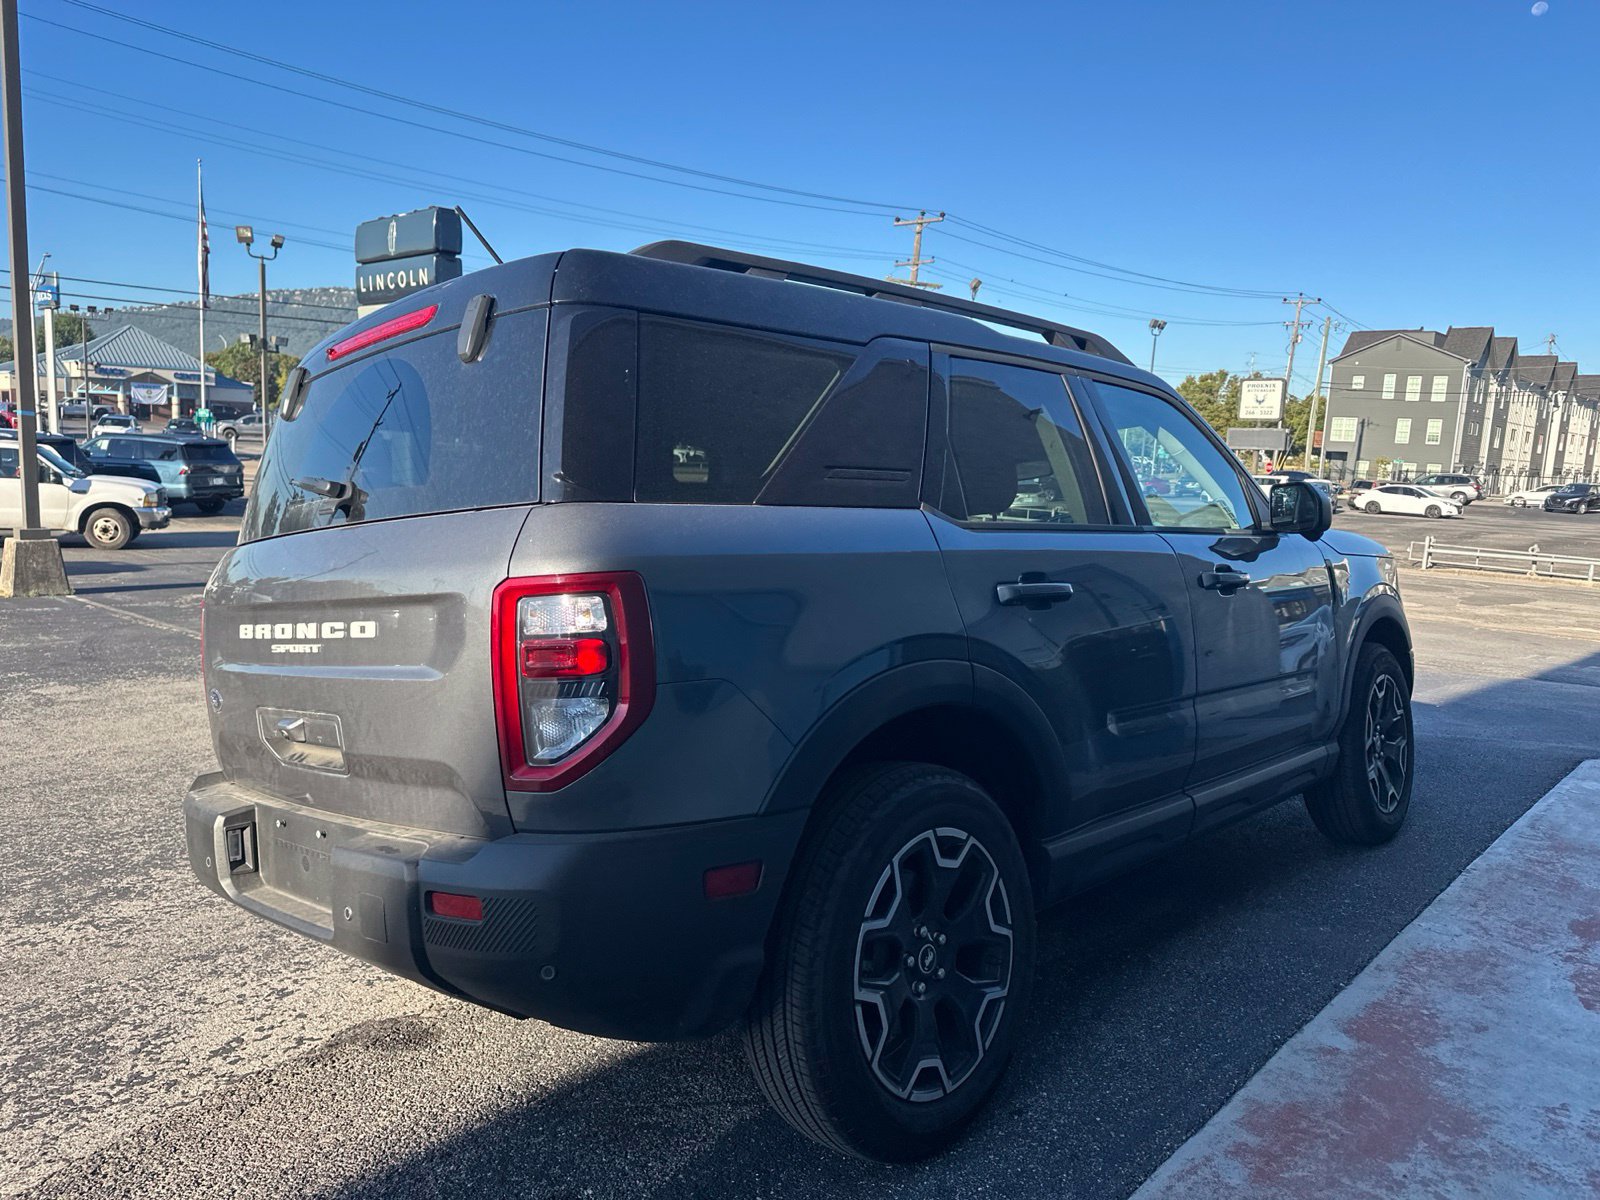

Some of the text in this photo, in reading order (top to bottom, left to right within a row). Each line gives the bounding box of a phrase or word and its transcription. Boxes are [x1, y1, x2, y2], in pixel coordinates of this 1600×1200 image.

[360, 267, 429, 292] LINCOLN
[239, 621, 377, 639] BRONCO
[271, 644, 322, 653] SPORT
